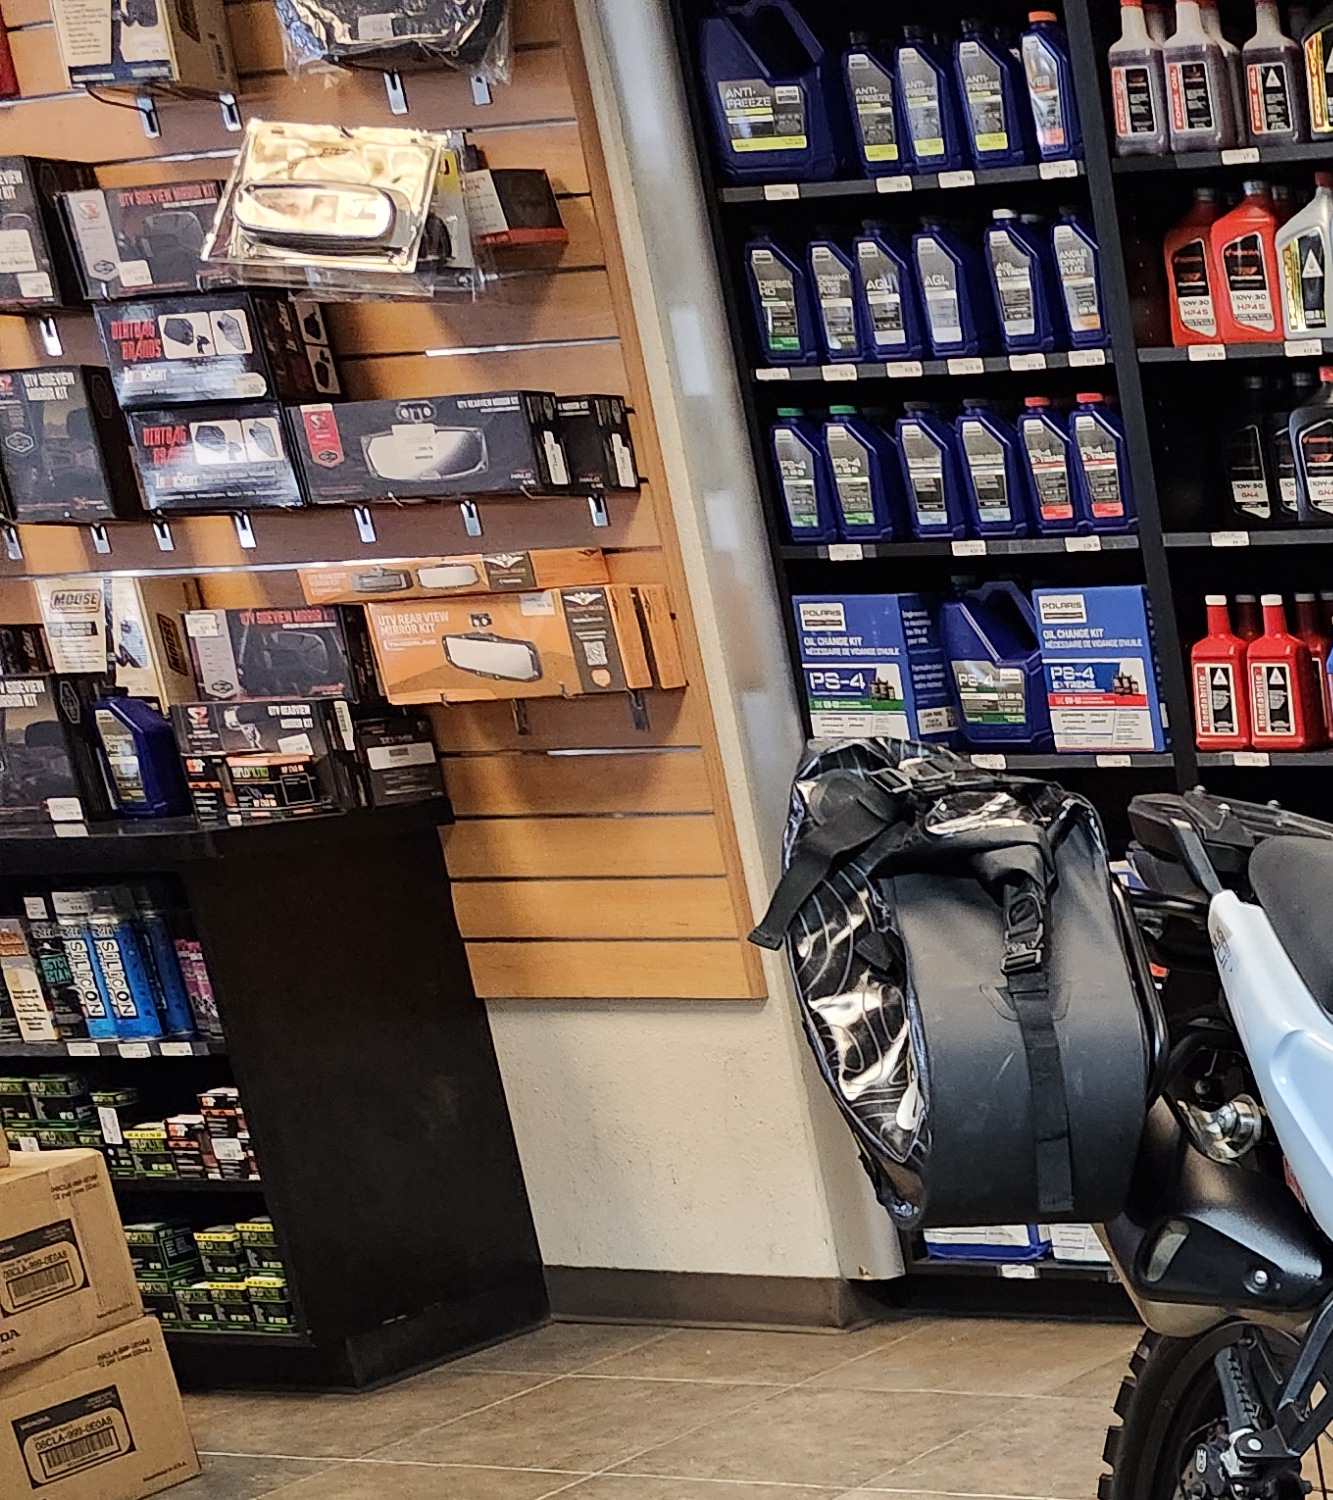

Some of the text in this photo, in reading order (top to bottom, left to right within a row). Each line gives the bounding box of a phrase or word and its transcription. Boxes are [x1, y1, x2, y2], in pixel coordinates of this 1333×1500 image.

[924, 276, 949, 286] AGL
[54, 591, 98, 606] MOOSE
[1042, 601, 1082, 610] POLARIS
[398, 613, 421, 626] REAR
[423, 612, 449, 624] VIEW
[803, 609, 842, 618] POLARIS
[414, 622, 435, 633] KIT
[1043, 628, 1104, 639] OIL CHANGE KIT
[159, 616, 187, 675] MOOSE
[804, 637, 862, 647] OIL CHANGE KIT
[1050, 666, 1094, 680] PS-4
[809, 671, 866, 690] PS-4
[959, 673, 995, 688] PS-4
[1201, 675, 1211, 728] Hondabrite
[1257, 674, 1267, 727] Hondabrite
